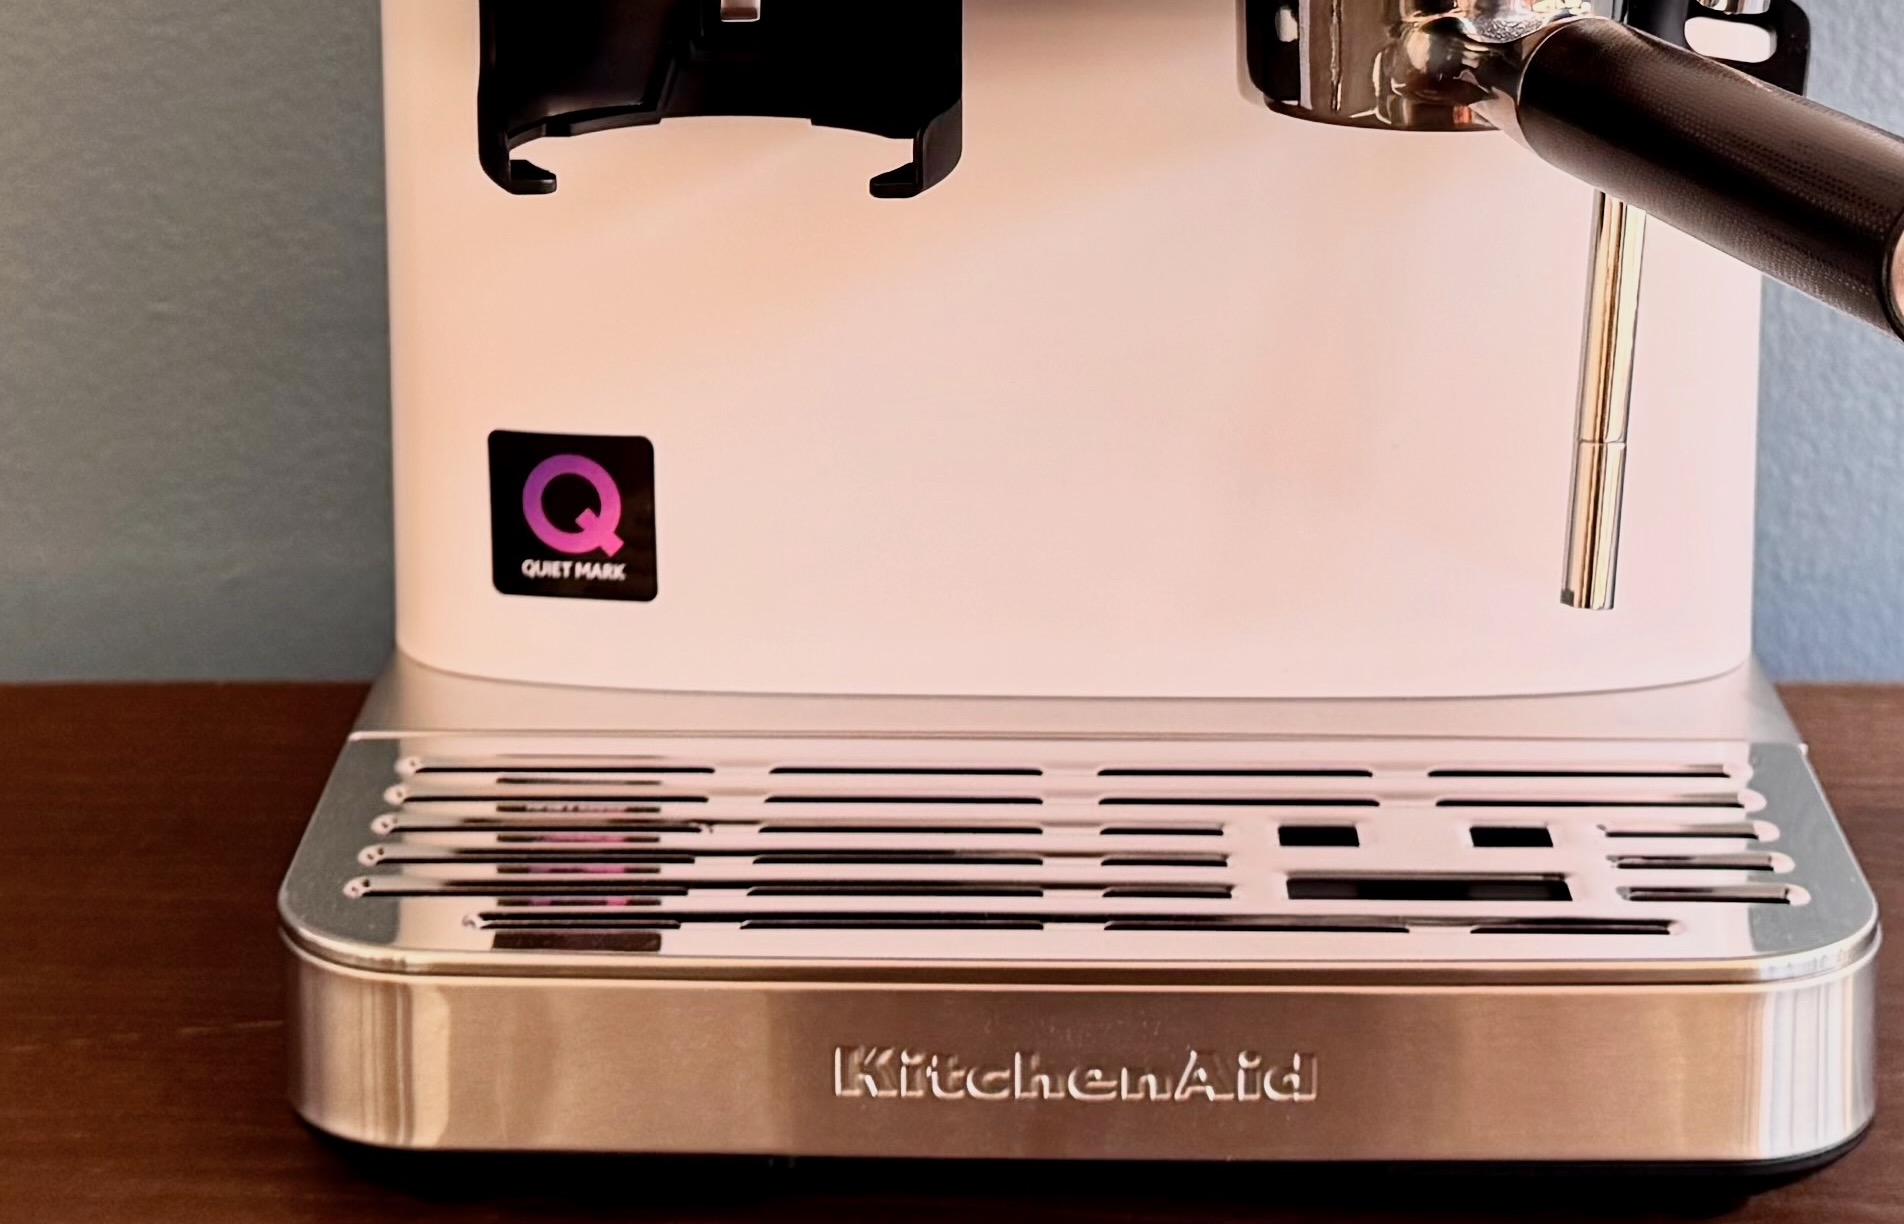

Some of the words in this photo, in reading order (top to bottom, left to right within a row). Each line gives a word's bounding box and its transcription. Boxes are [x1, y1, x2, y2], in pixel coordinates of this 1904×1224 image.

[521, 558, 573, 580] QUIET
[574, 560, 628, 582] MARK
[832, 1044, 1319, 1102] KitchenAid
